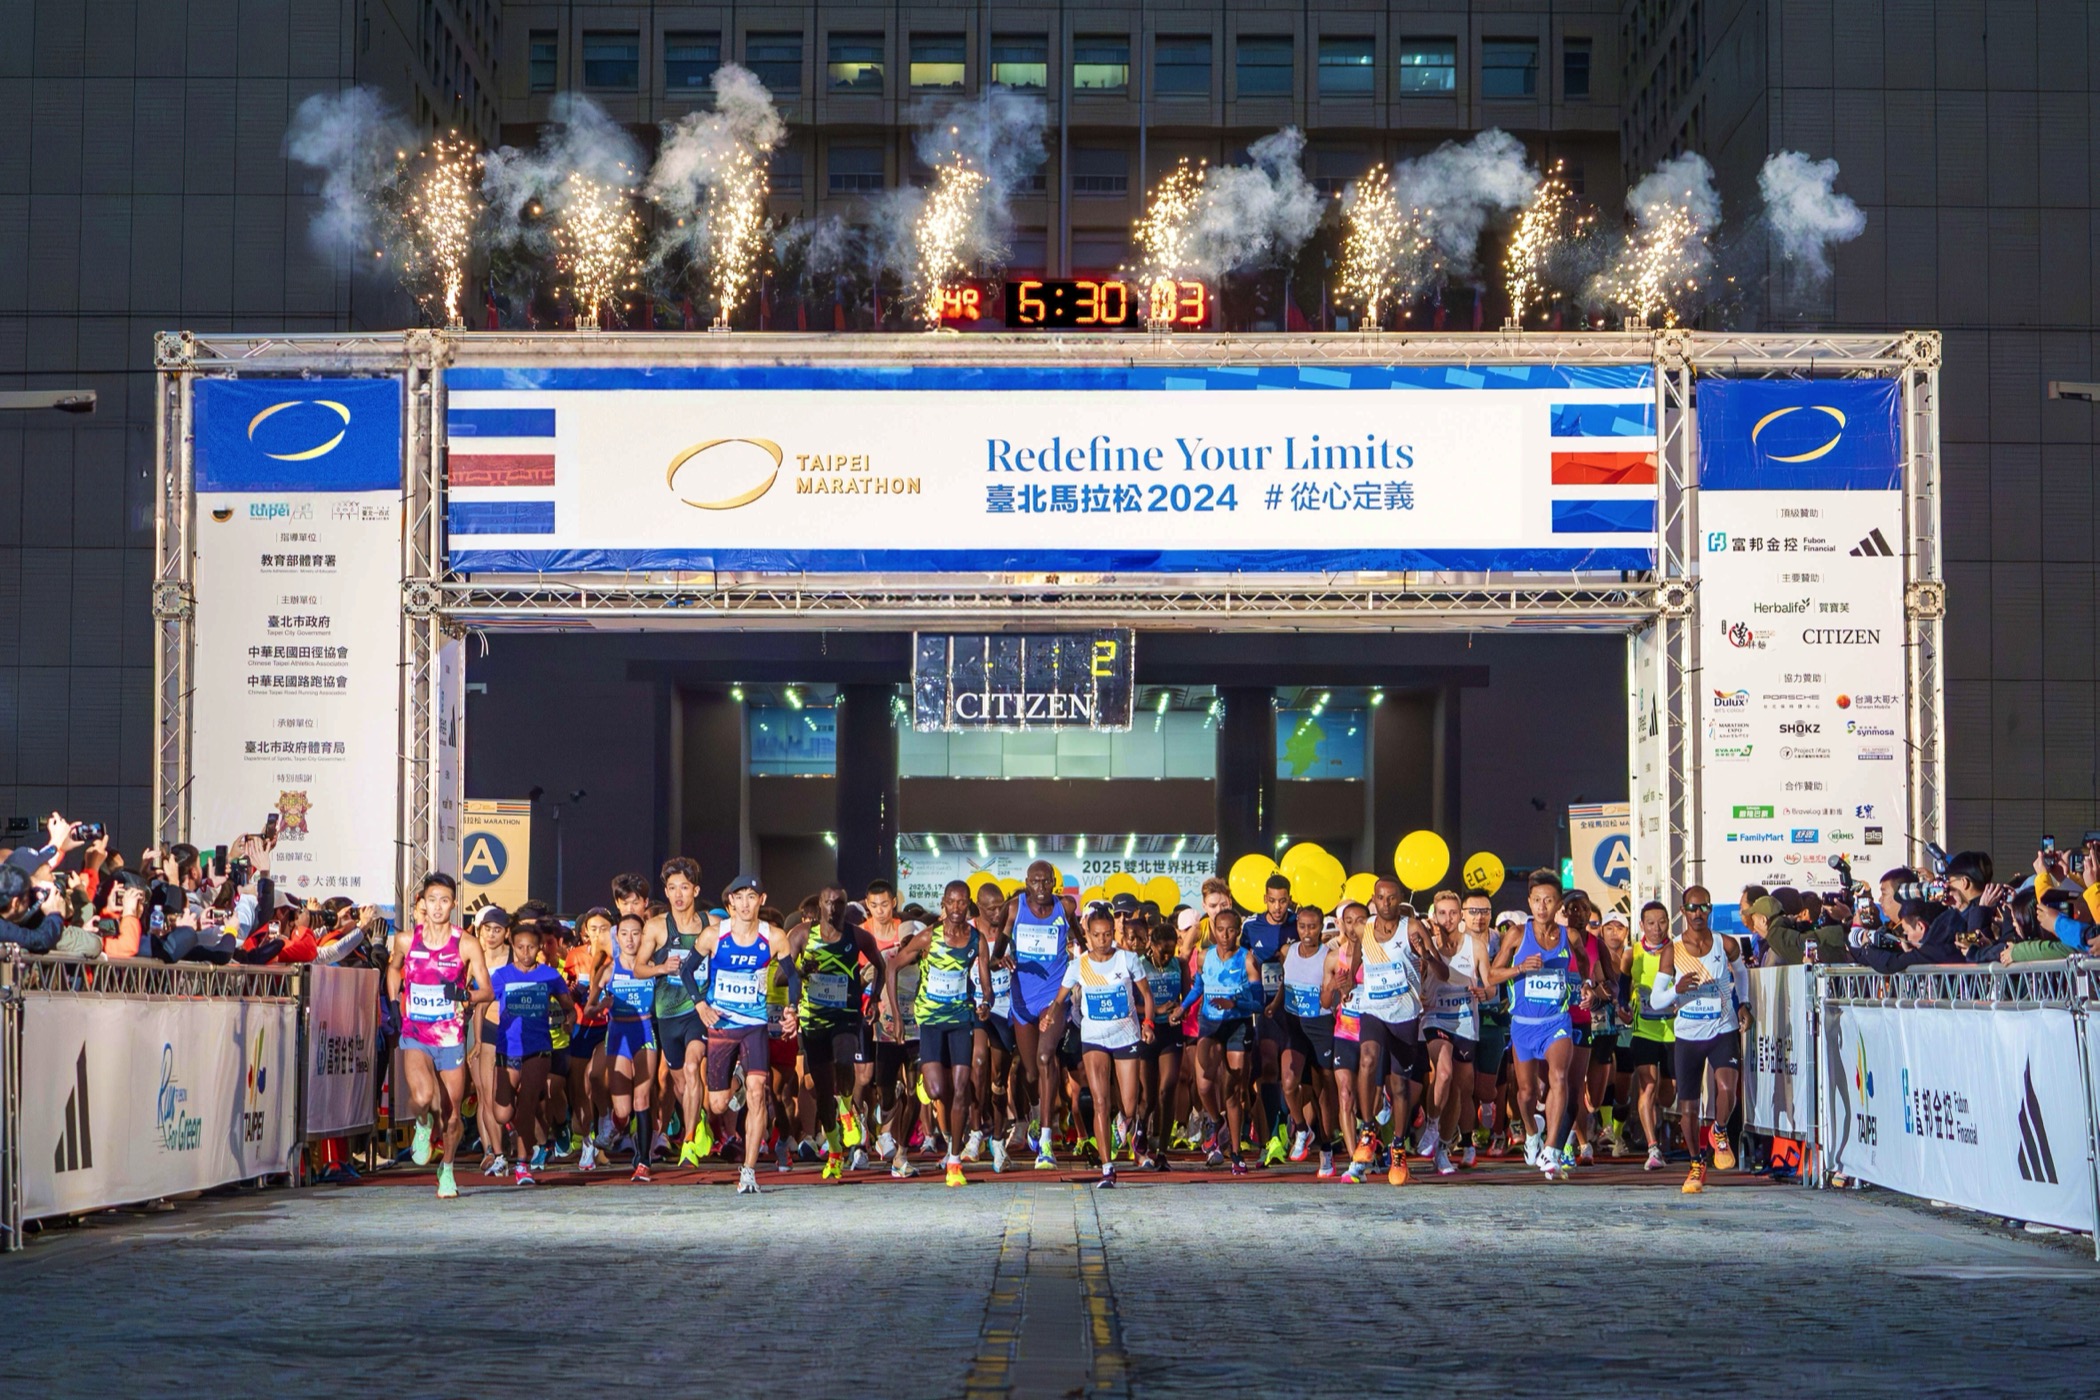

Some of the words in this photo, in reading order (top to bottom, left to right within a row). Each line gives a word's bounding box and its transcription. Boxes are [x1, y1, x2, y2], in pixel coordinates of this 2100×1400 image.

[1020, 281, 1126, 322] 6:30
[986, 435, 1163, 472] Redefine
[1175, 437, 1272, 471] Your
[1284, 434, 1414, 470] Limits
[796, 454, 869, 471] TAIPEI
[796, 477, 921, 494] MARATHON
[986, 484, 1238, 513] 臺北馬拉松2024
[280, 533, 316, 542] 指導單位
[1732, 538, 1798, 552] 富邦金控
[261, 554, 336, 567] 教育部體育署
[1782, 574, 1819, 583] 主要贊助
[281, 596, 317, 605] 主辦單位
[1754, 602, 1806, 613] Herbalife
[268, 616, 330, 628] 臺北市政府
[1802, 629, 1881, 644] CITIZEN
[248, 646, 348, 658] 中華民國田徑協會
[1092, 641, 1116, 676] 2
[247, 675, 347, 688] 中華民國路跑協會
[1784, 674, 1821, 683] 協力贊助
[955, 693, 1093, 718] CITIZEN
[1714, 698, 1744, 706] Dulux
[1856, 695, 1899, 704] 台灣大哥大
[277, 718, 313, 728] 承辦單位
[1780, 724, 1820, 733] SHOKZ
[1857, 729, 1894, 737] synmosa
[244, 741, 345, 754] 臺北市政府體育局
[1785, 782, 1823, 791] 合作贊助
[1792, 808, 1821, 816] Bravelog
[1580, 820, 1617, 829] 全程馬拉松
[1740, 834, 1784, 842] FamilyMart
[276, 852, 312, 861] 協辦單位
[464, 838, 499, 874] A
[1740, 854, 1773, 864] uno
[313, 876, 361, 887] 大漢集團
[730, 955, 757, 966] TPE
[718, 983, 756, 995] 11013
[1528, 980, 1566, 990] 10478
[1439, 997, 1471, 1006] 11005
[1954, 1091, 1969, 1114] Fubon
[1914, 1087, 1954, 1140] 富邦金控
[179, 1110, 201, 1151] Green
[244, 1111, 264, 1142] TAIPEI
[1857, 1113, 1877, 1146] TAIPEI
[1957, 1121, 1978, 1145] Financial
